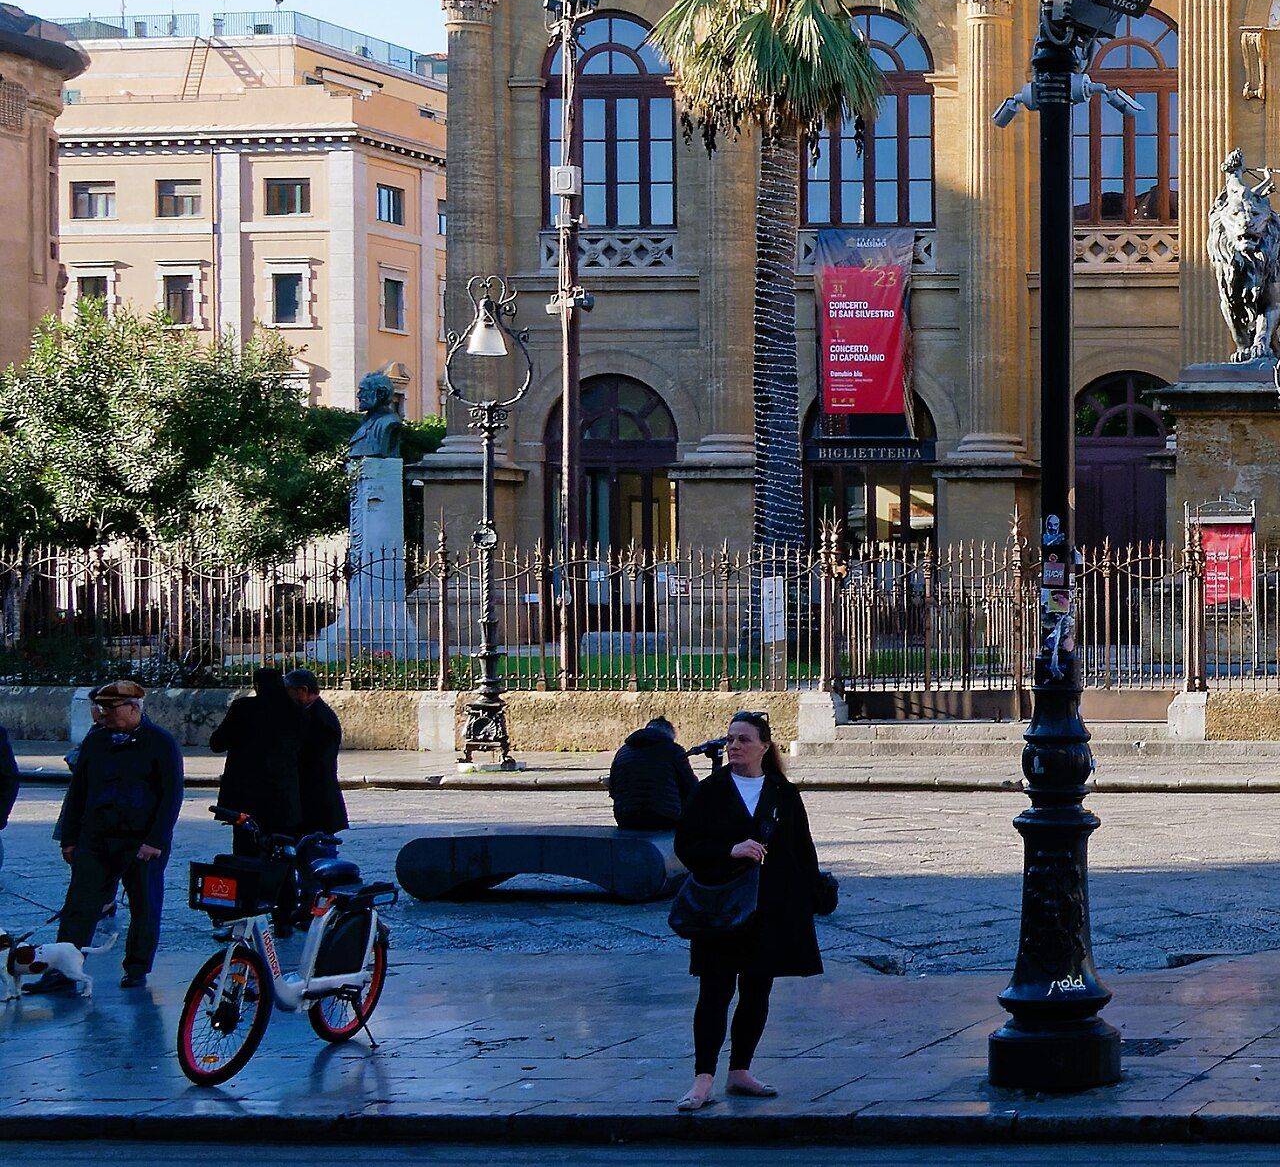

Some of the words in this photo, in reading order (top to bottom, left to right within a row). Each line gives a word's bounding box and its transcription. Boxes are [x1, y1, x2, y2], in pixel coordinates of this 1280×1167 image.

[874, 271, 897, 287] 23
[833, 284, 843, 293] 31
[829, 301, 869, 310] CONCERTO
[829, 310, 837, 318] DI
[838, 310, 854, 318] SAN
[855, 309, 895, 318] SILVESTRO
[830, 345, 869, 353] CONCERTO
[830, 354, 838, 362] DI
[839, 354, 885, 362] CAPODANNO
[818, 448, 921, 459] BIGLIETTERIA
